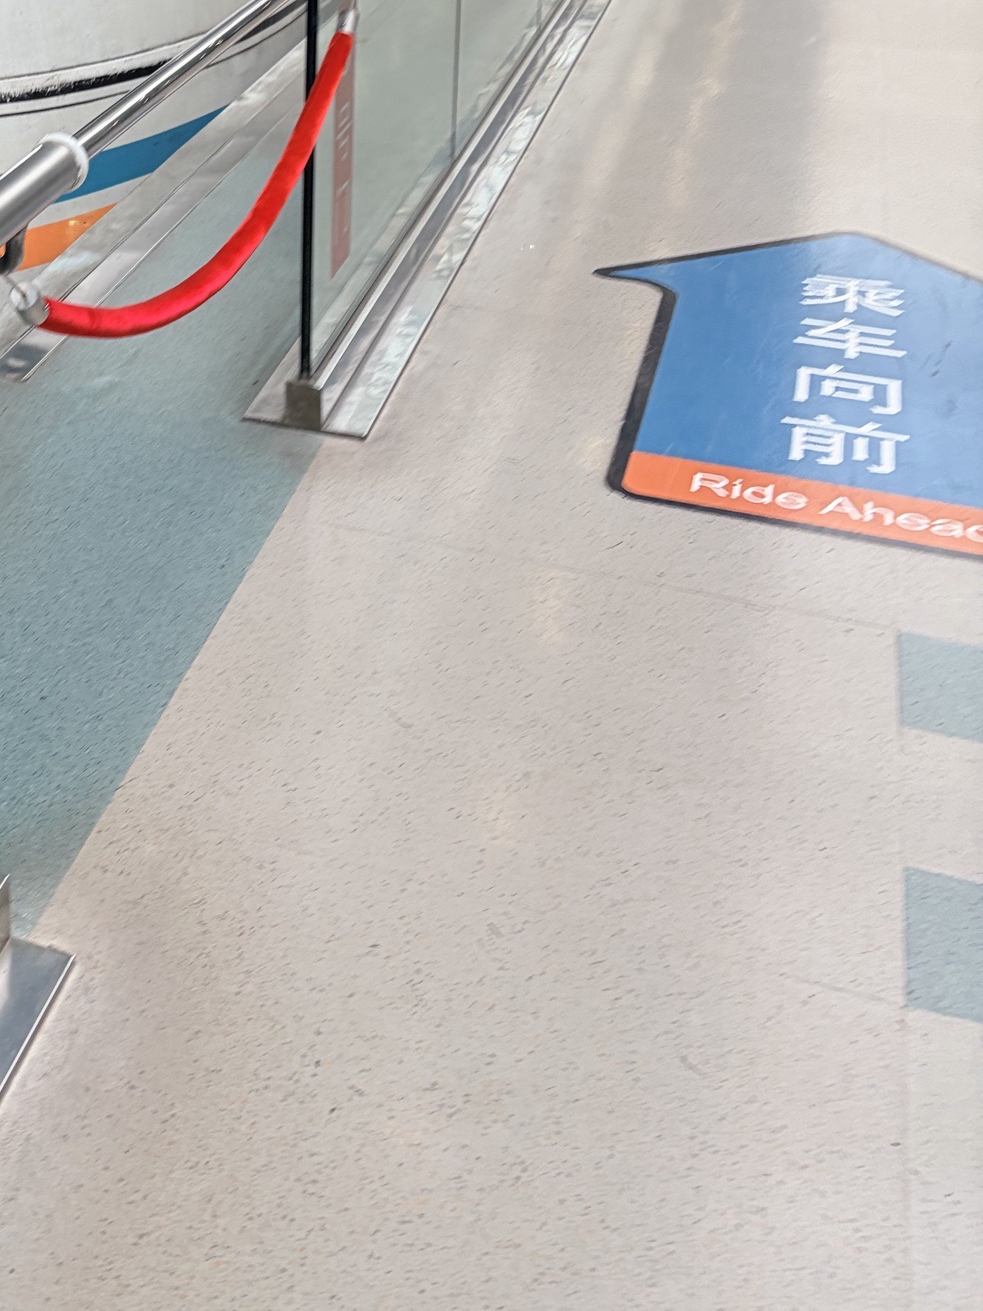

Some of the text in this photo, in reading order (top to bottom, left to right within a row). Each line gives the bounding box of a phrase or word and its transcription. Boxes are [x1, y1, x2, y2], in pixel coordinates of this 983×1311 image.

[781, 274, 910, 475] 乘车向前
[689, 472, 809, 510] Ride
